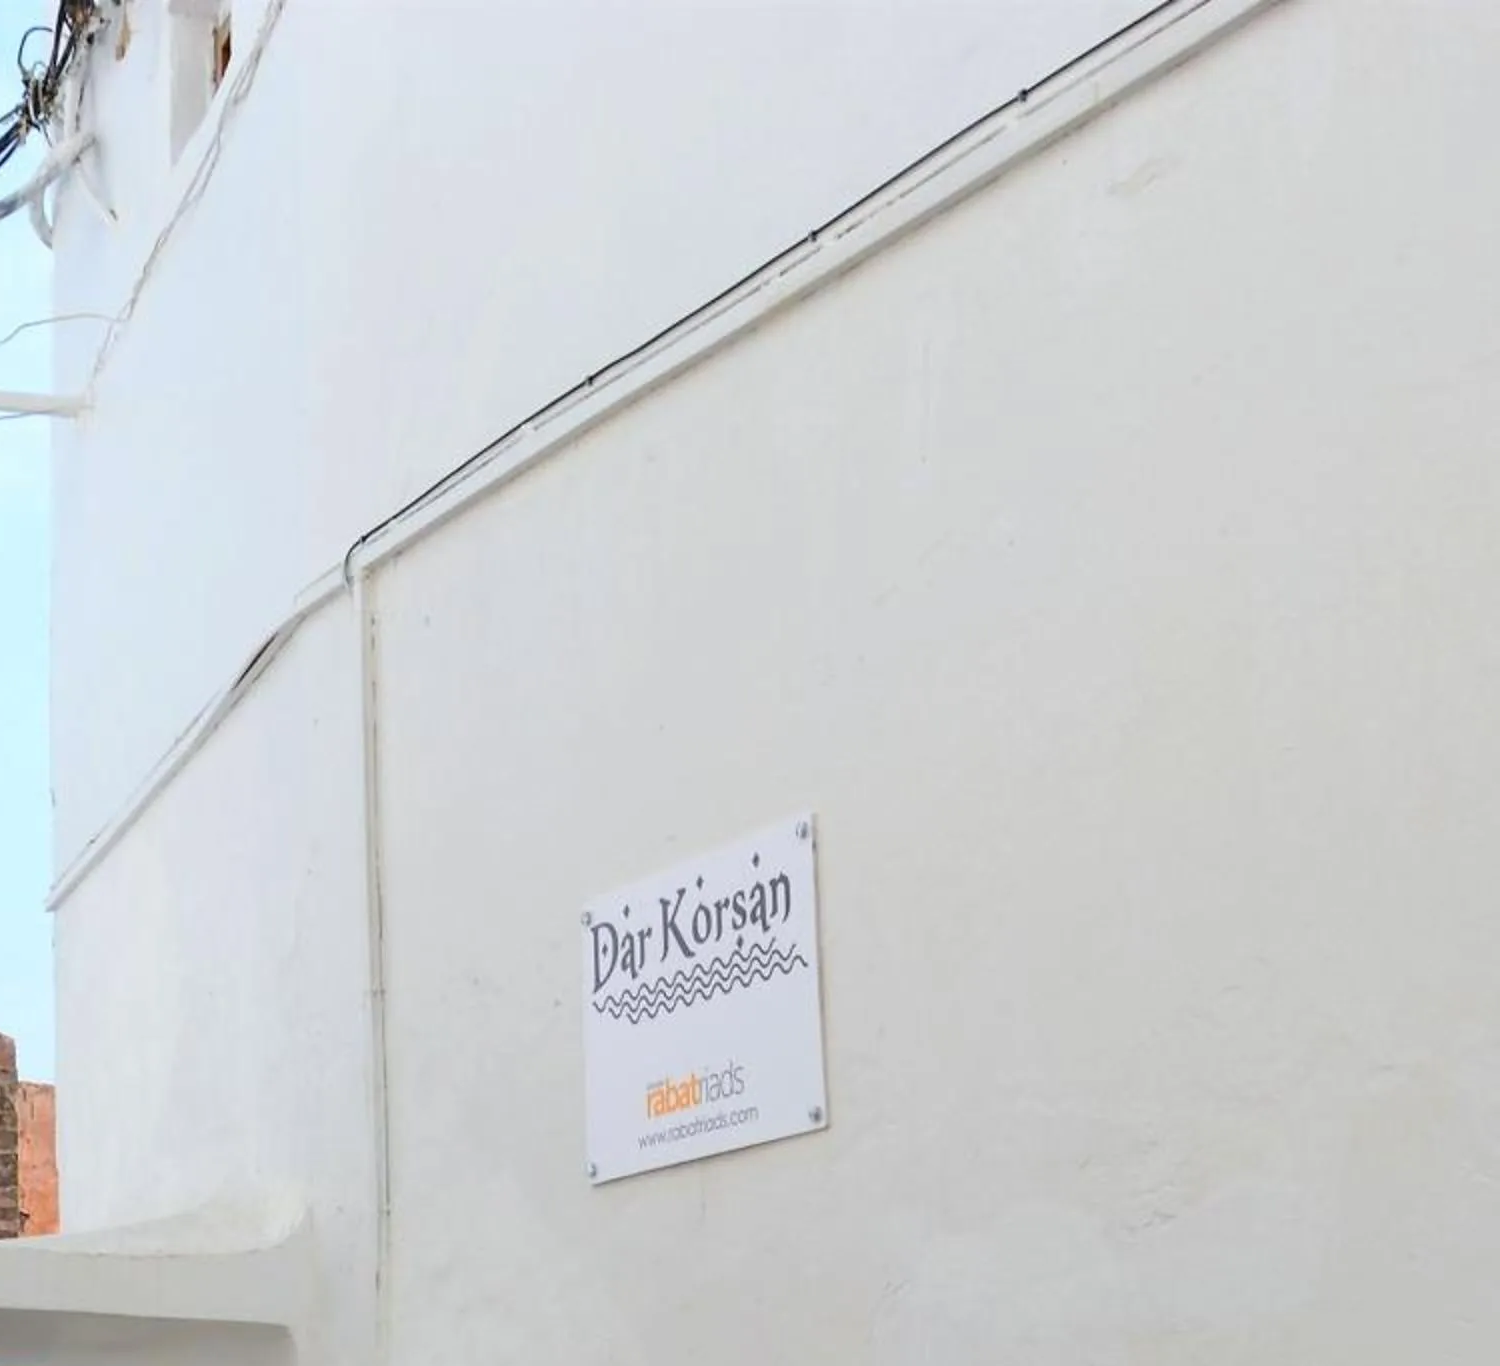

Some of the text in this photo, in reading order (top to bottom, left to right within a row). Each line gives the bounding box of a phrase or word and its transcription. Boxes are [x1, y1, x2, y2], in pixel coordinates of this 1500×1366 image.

[591, 862, 791, 994] Dar Korsan
[646, 1058, 746, 1120] rabatriads
